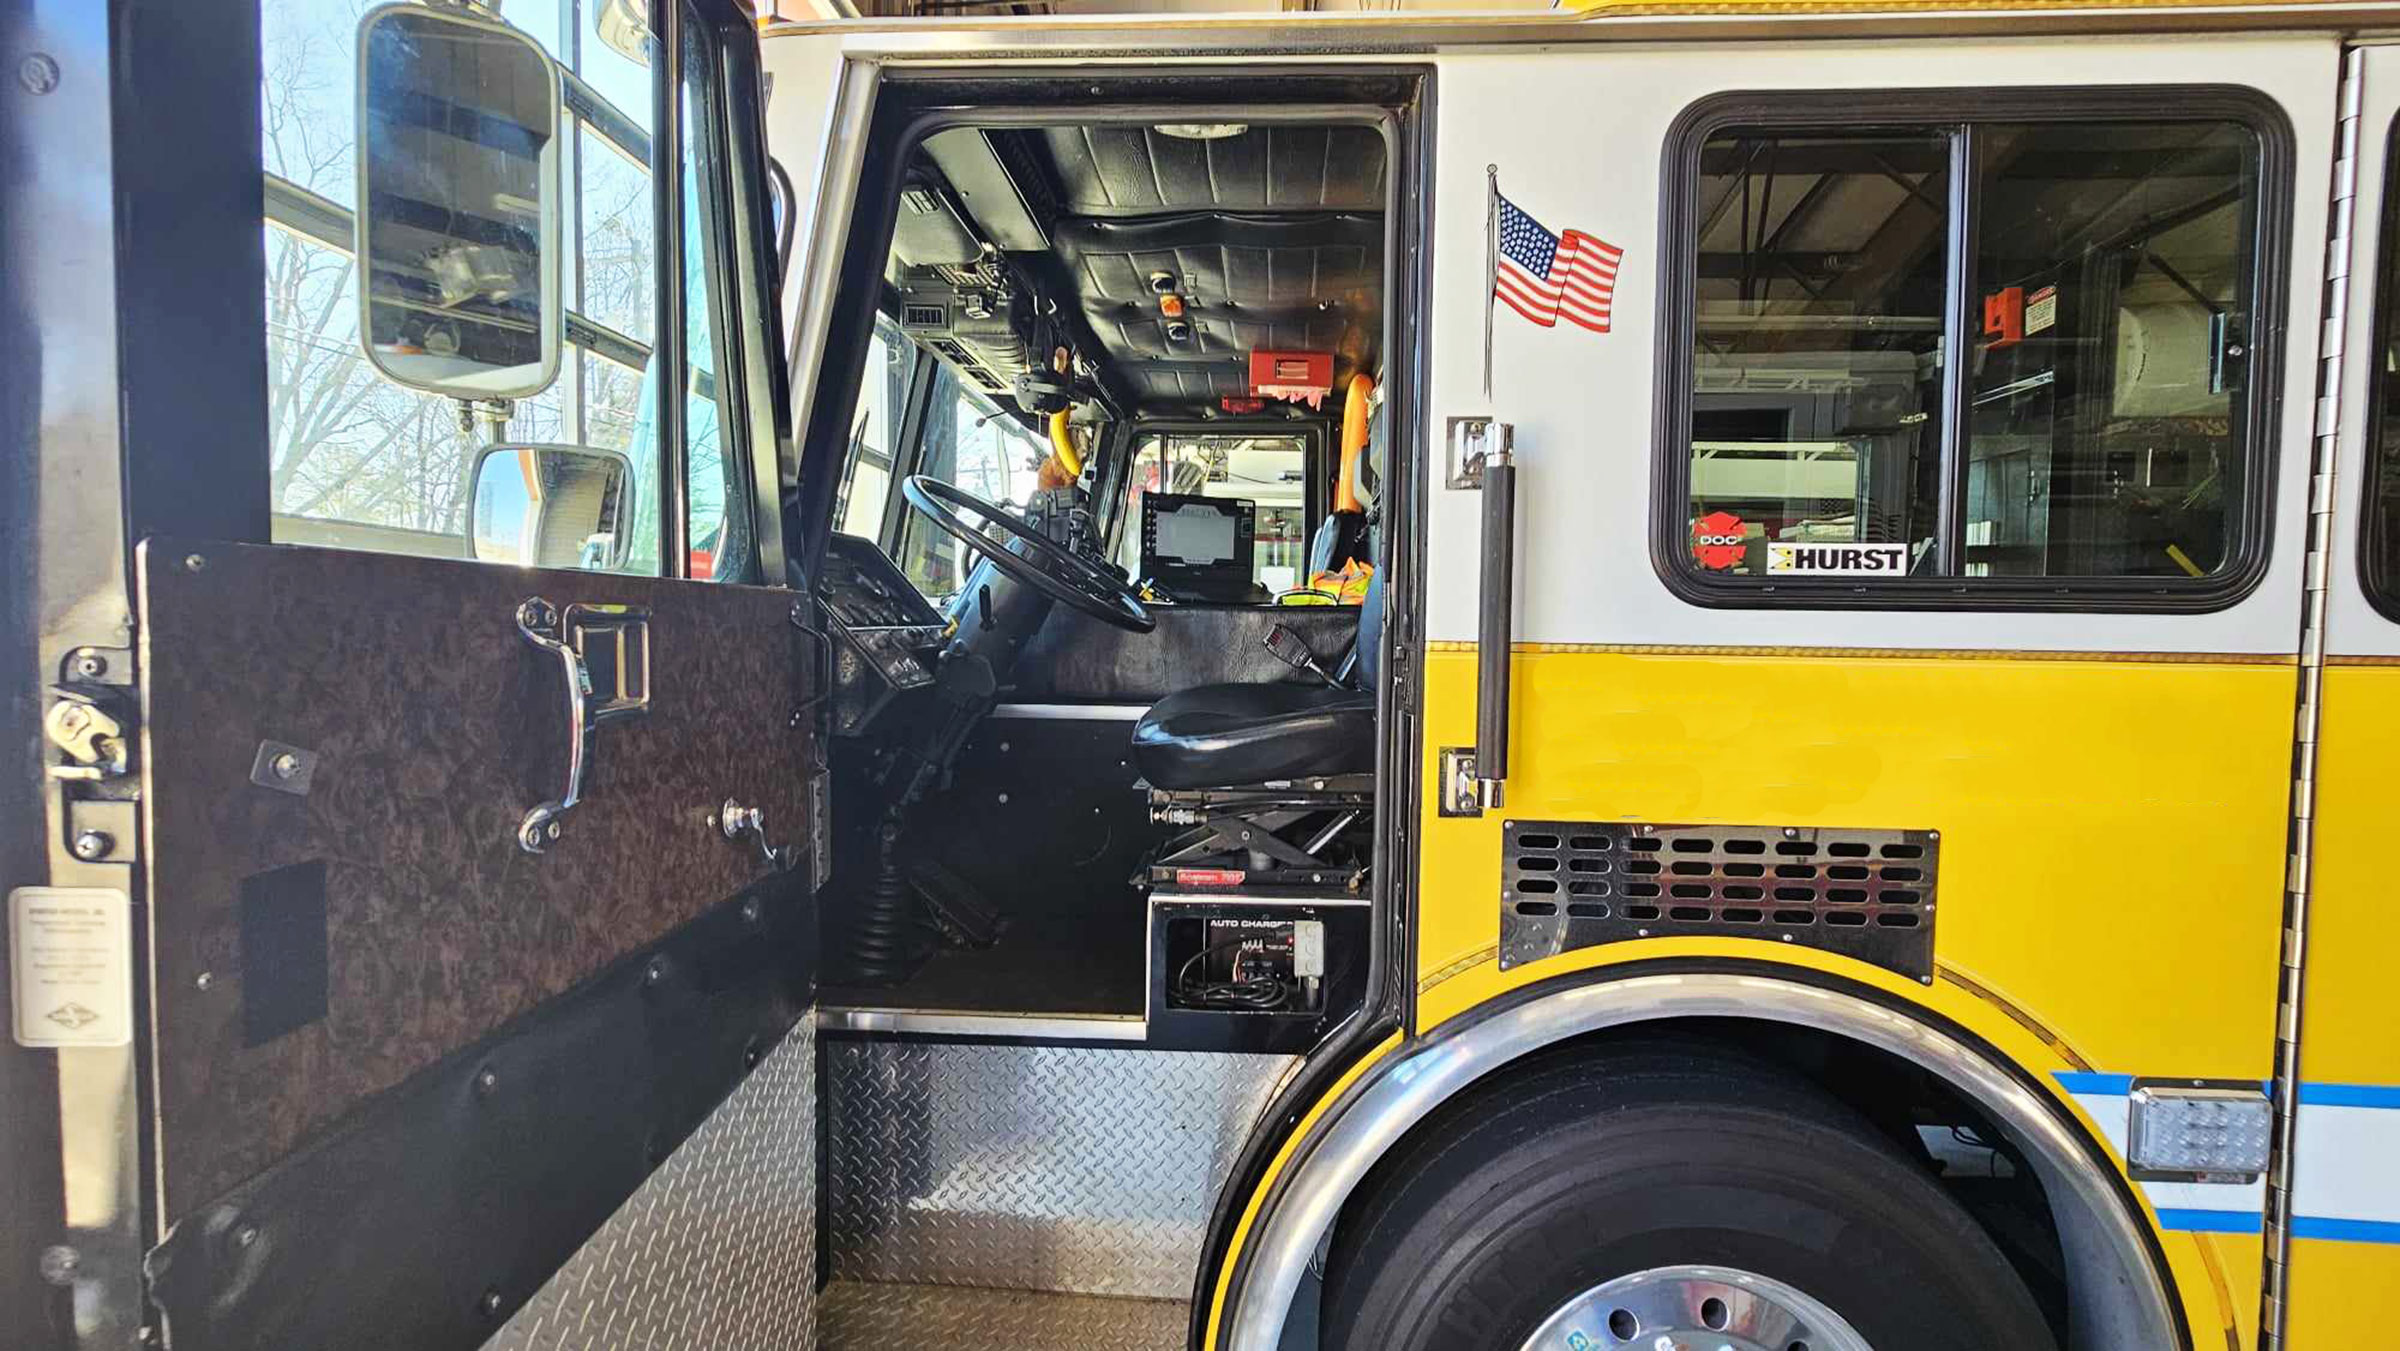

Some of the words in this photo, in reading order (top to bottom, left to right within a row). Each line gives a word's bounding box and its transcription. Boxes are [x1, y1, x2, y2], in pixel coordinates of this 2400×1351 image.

[1700, 535, 1737, 546] DOC
[1794, 548, 1903, 570] HURST
[1210, 919, 1239, 928] AUTO
